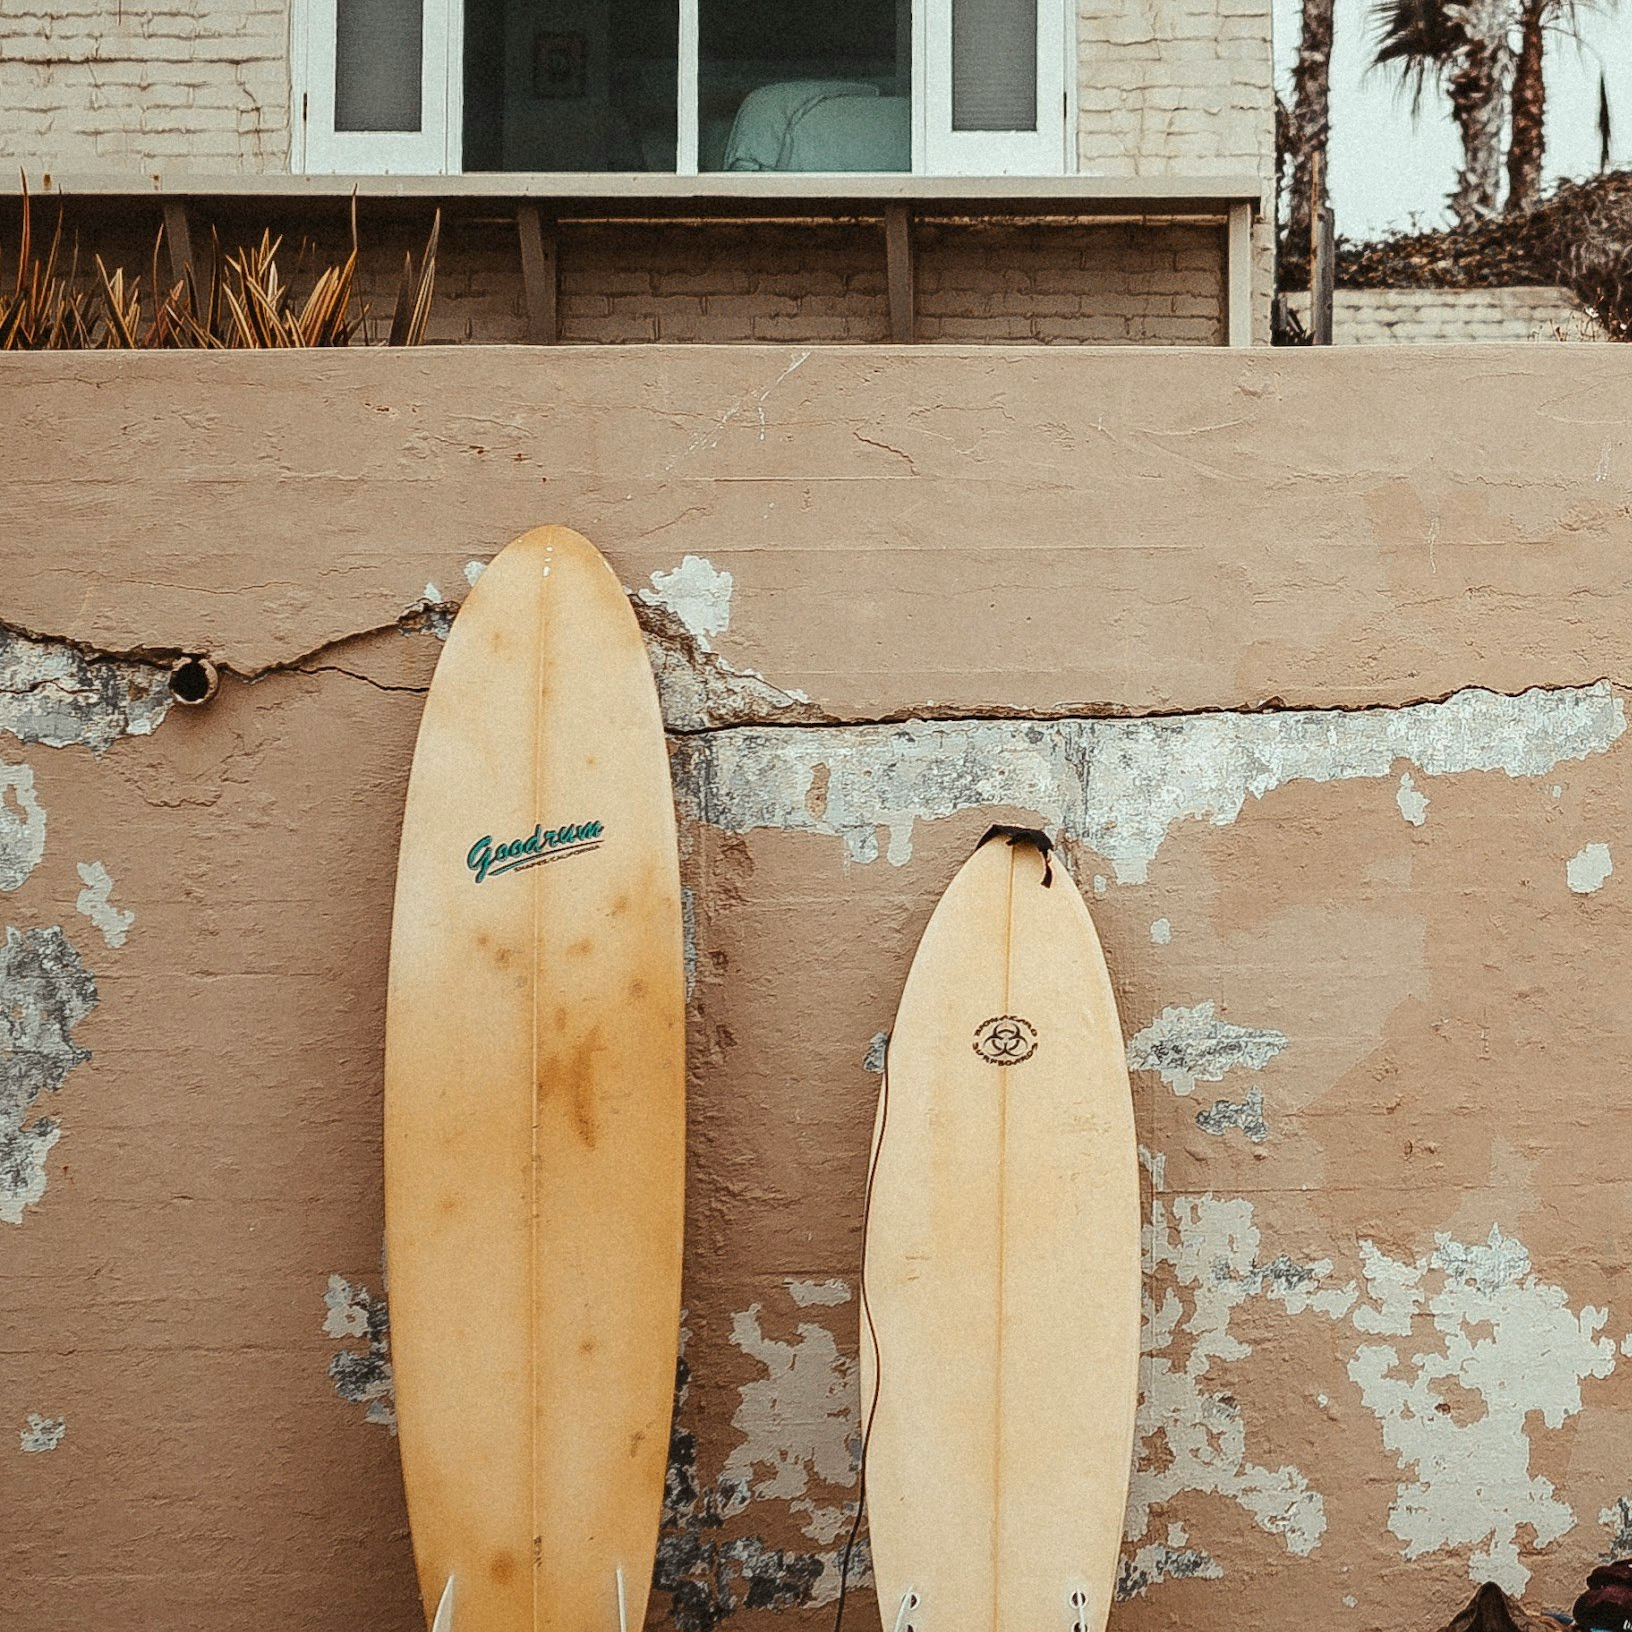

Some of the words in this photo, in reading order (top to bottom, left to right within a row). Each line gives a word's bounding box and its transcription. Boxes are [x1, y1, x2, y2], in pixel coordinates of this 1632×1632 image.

[467, 820, 604, 883] Goodrum
[974, 1014, 1037, 1037] BIOHAZARD
[972, 1042, 1038, 1066] SURFBOARDS
